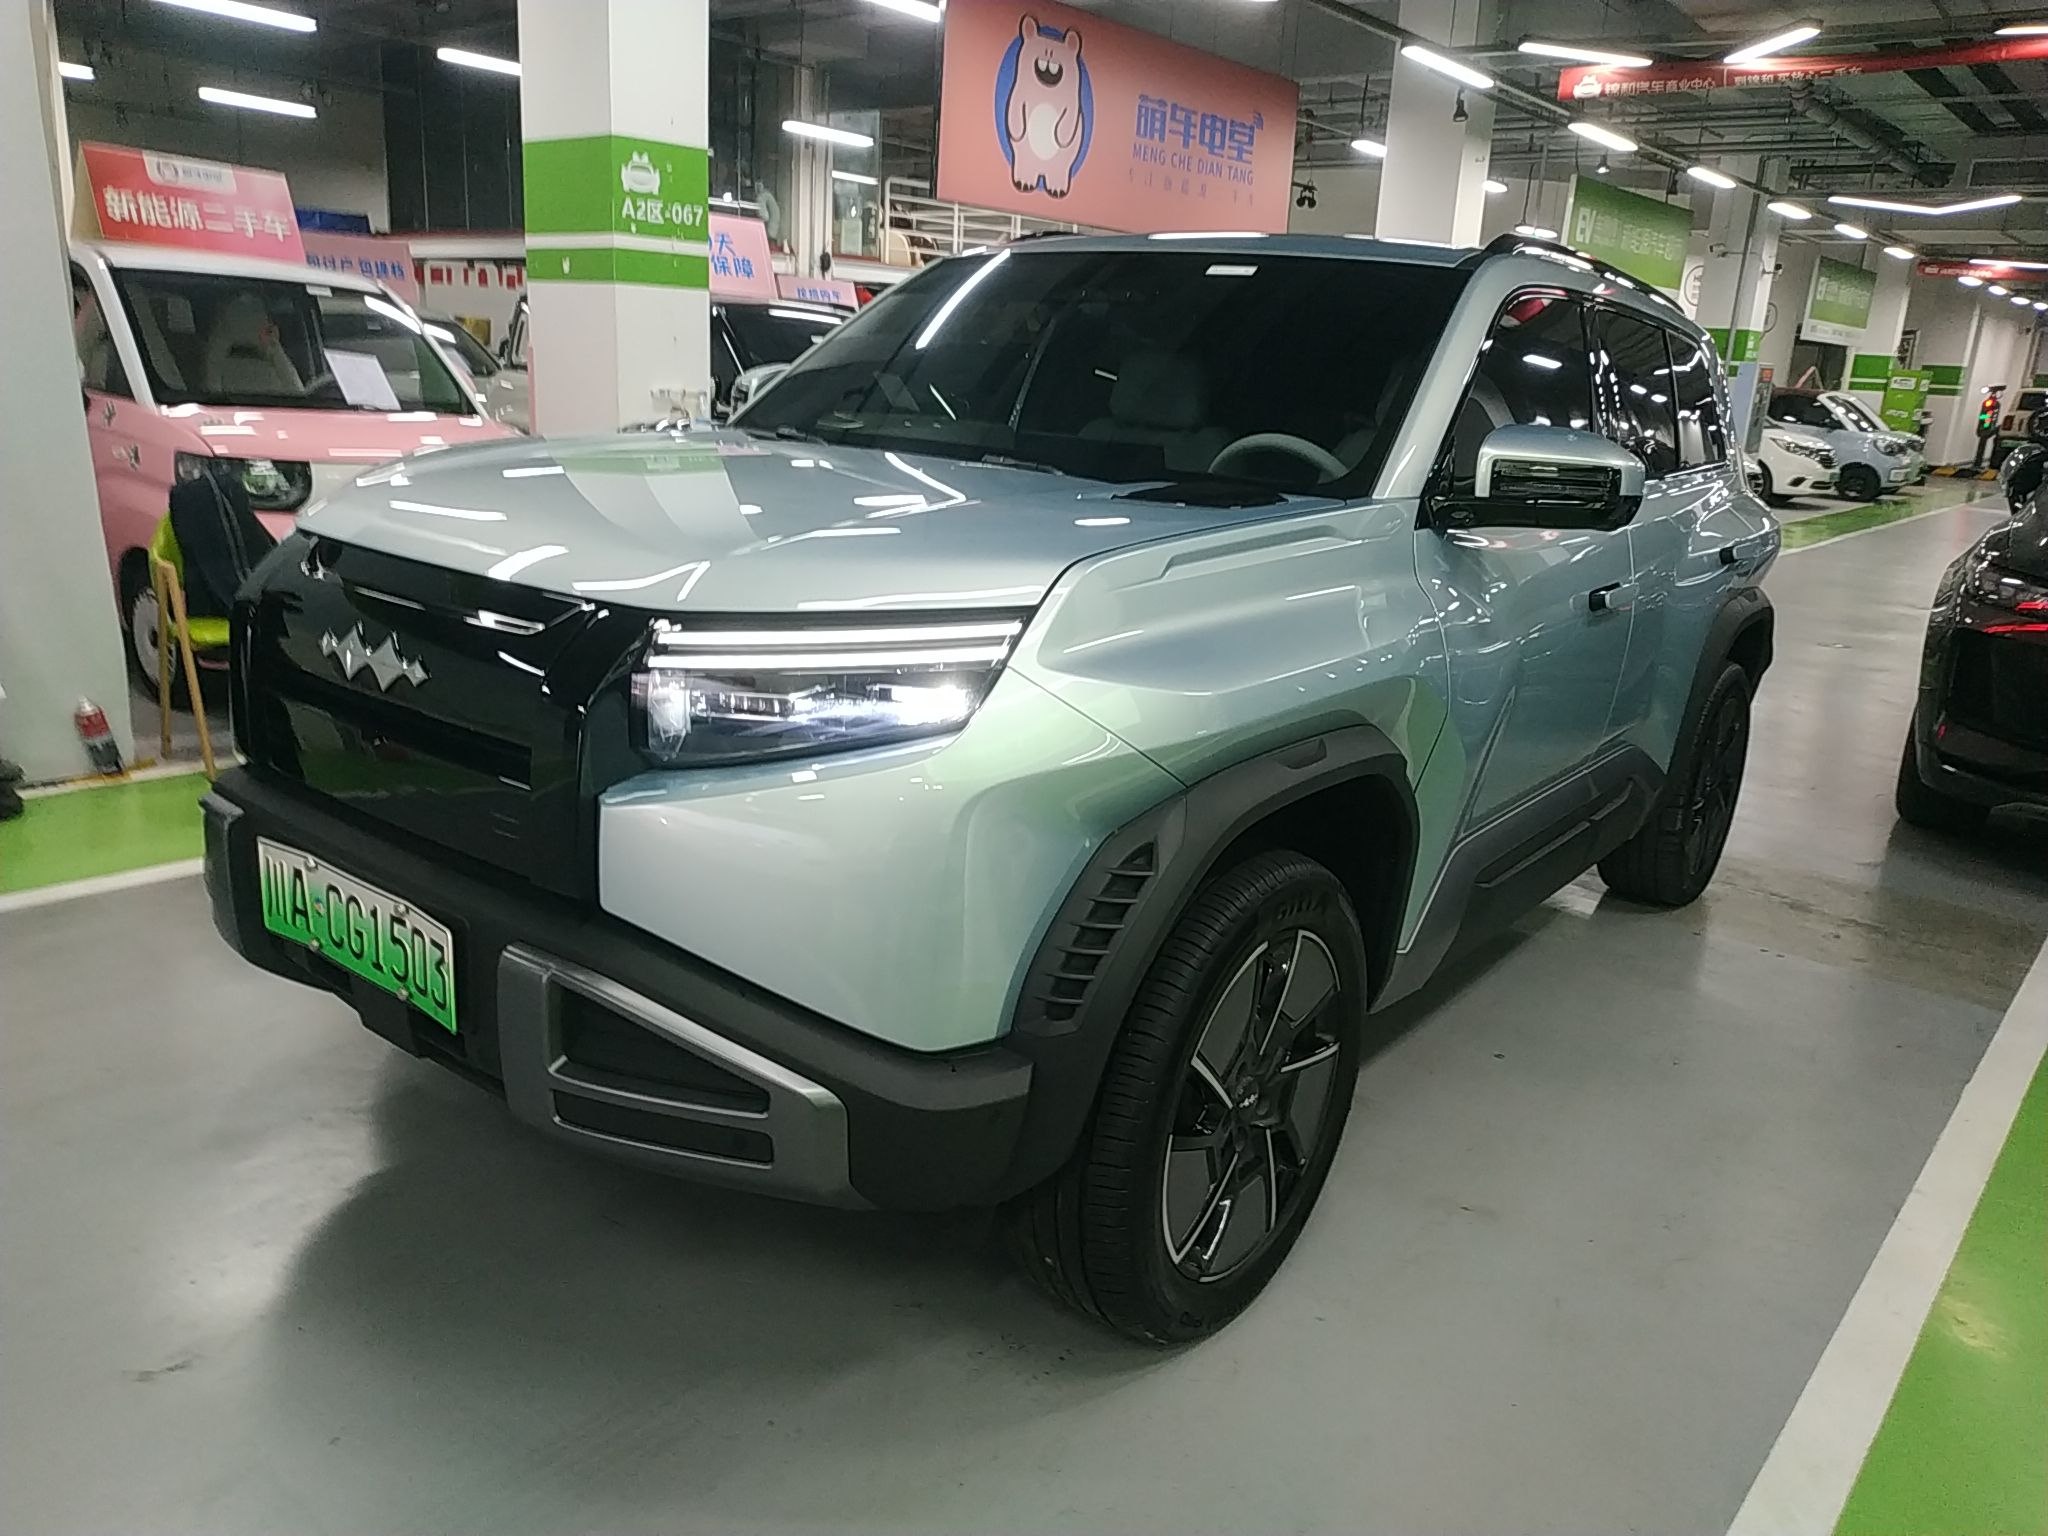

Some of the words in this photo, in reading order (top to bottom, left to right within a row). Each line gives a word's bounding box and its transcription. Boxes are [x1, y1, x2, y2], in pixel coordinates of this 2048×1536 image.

[1132, 143, 1166, 166] MENG
[1171, 152, 1193, 172] CHE
[1197, 158, 1223, 179] DIAN
[1227, 165, 1254, 186] TANG
[103, 184, 292, 242] 新能源二手车
[711, 254, 755, 279] 保障
